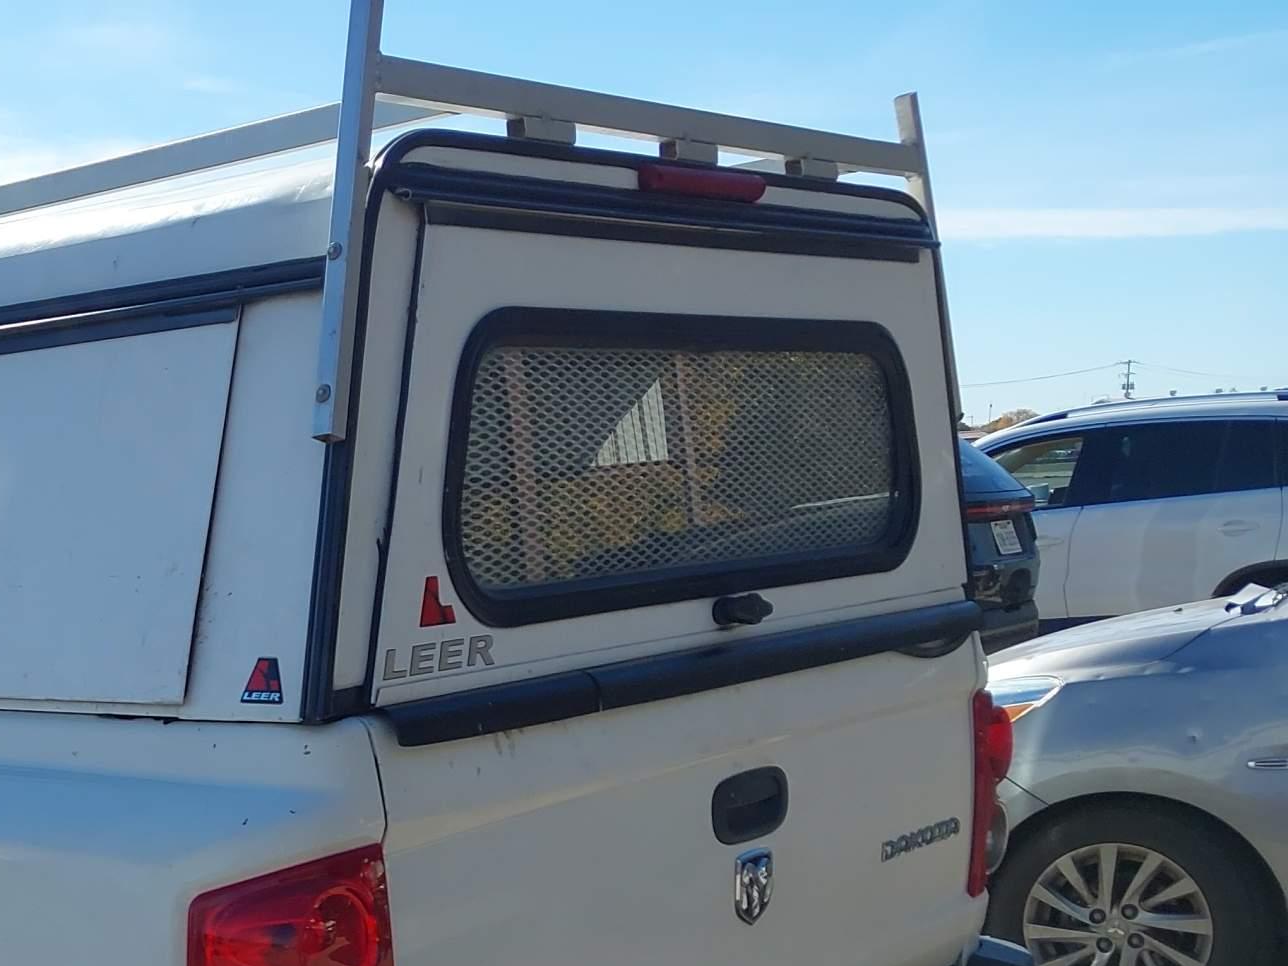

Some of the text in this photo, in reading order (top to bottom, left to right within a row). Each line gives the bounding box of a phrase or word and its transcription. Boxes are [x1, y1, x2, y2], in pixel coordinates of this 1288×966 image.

[383, 635, 495, 680] LEER
[242, 691, 281, 701] LEER
[881, 816, 960, 862] DAKOTA
